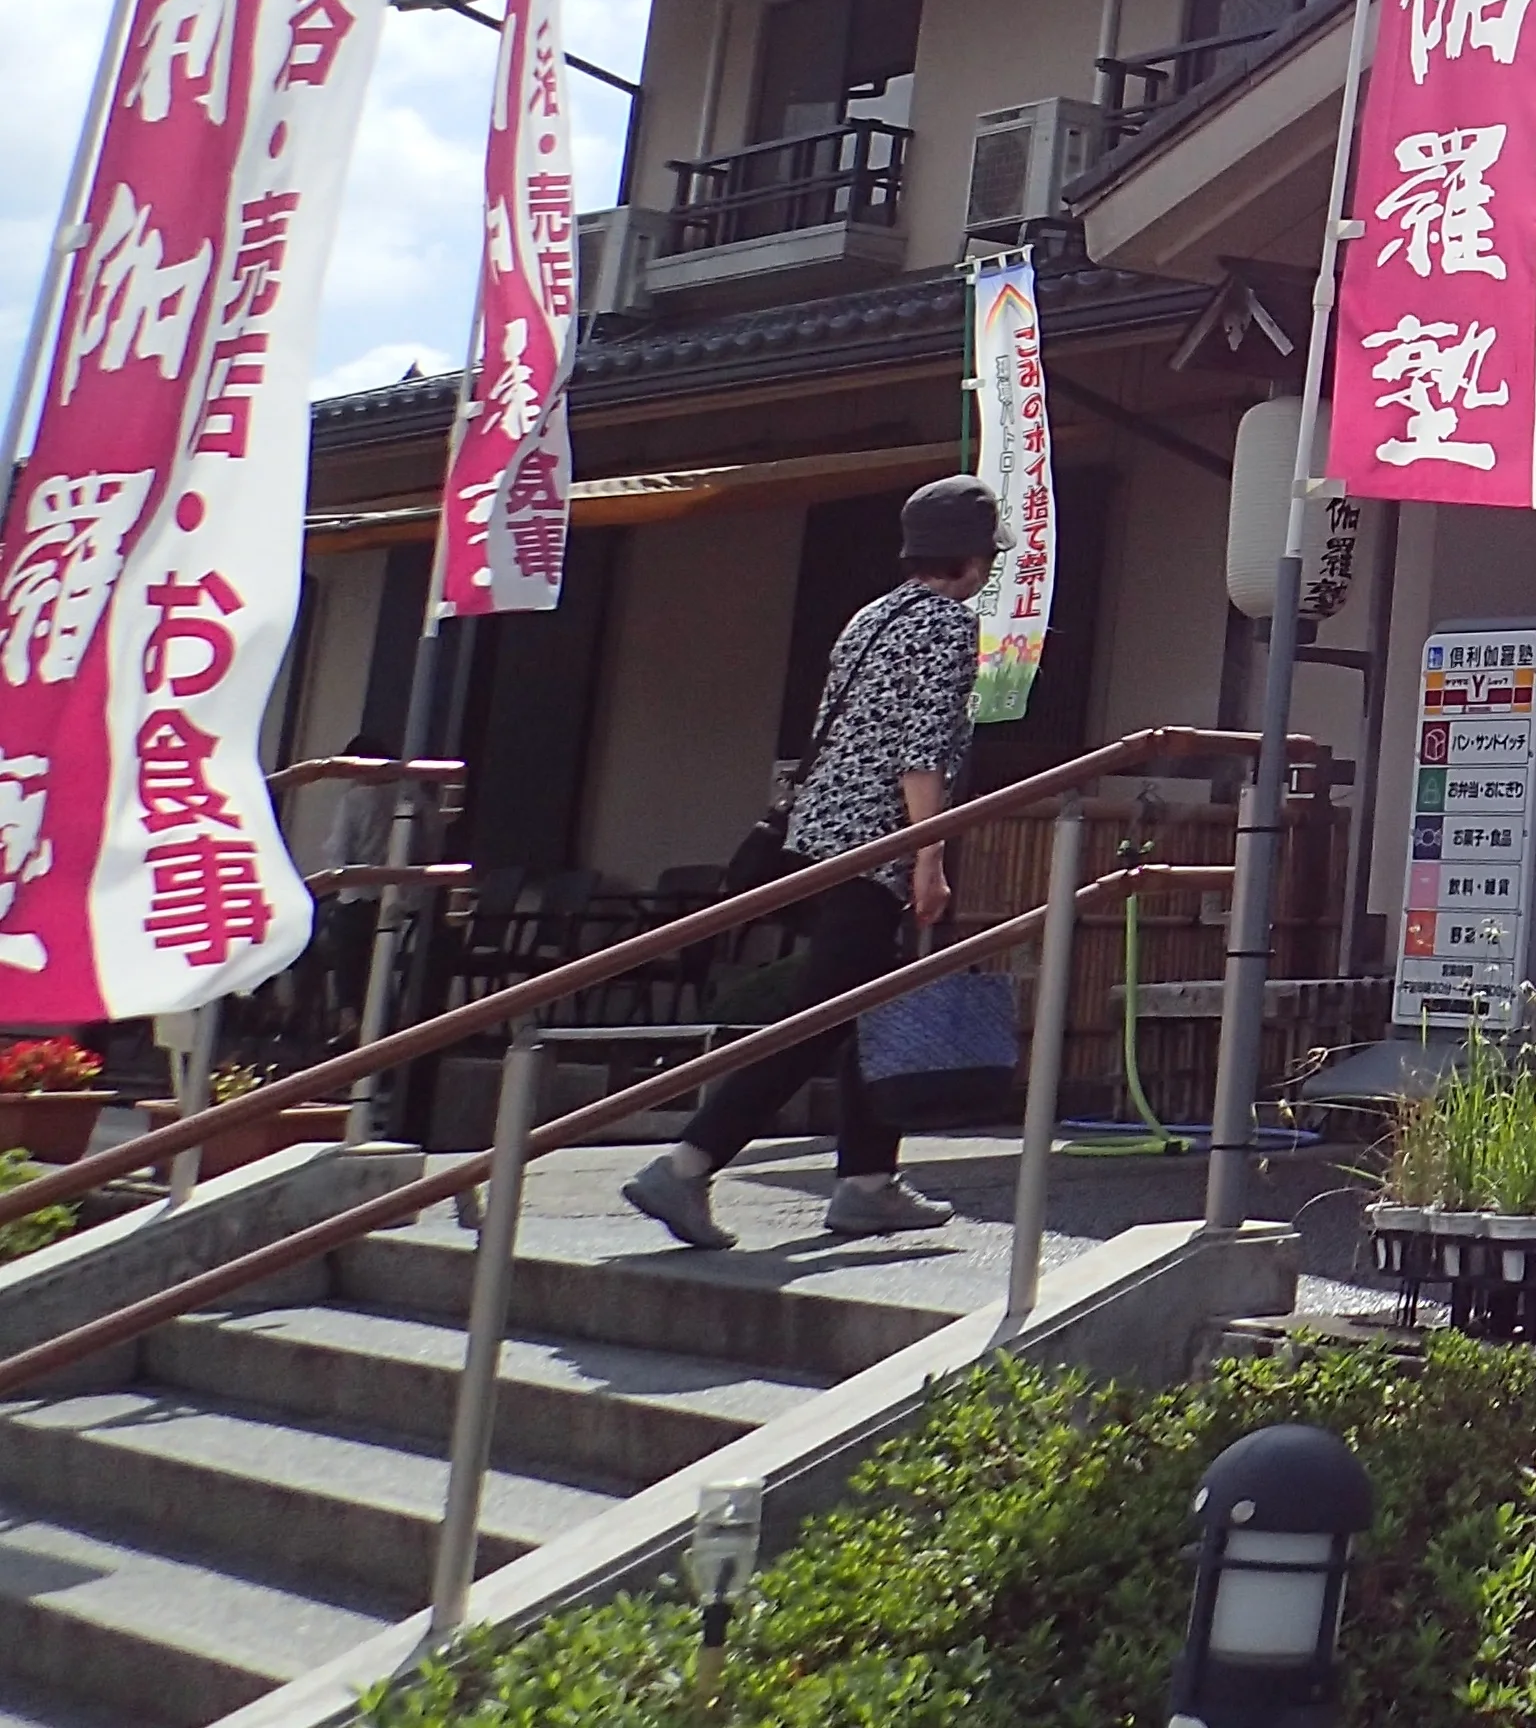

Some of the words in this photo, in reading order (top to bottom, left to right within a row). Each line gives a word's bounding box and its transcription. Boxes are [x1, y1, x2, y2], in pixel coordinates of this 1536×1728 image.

[1452, 734, 1526, 751] パン・サンドイッチ
[1448, 780, 1524, 799] お弁当・おにぎり
